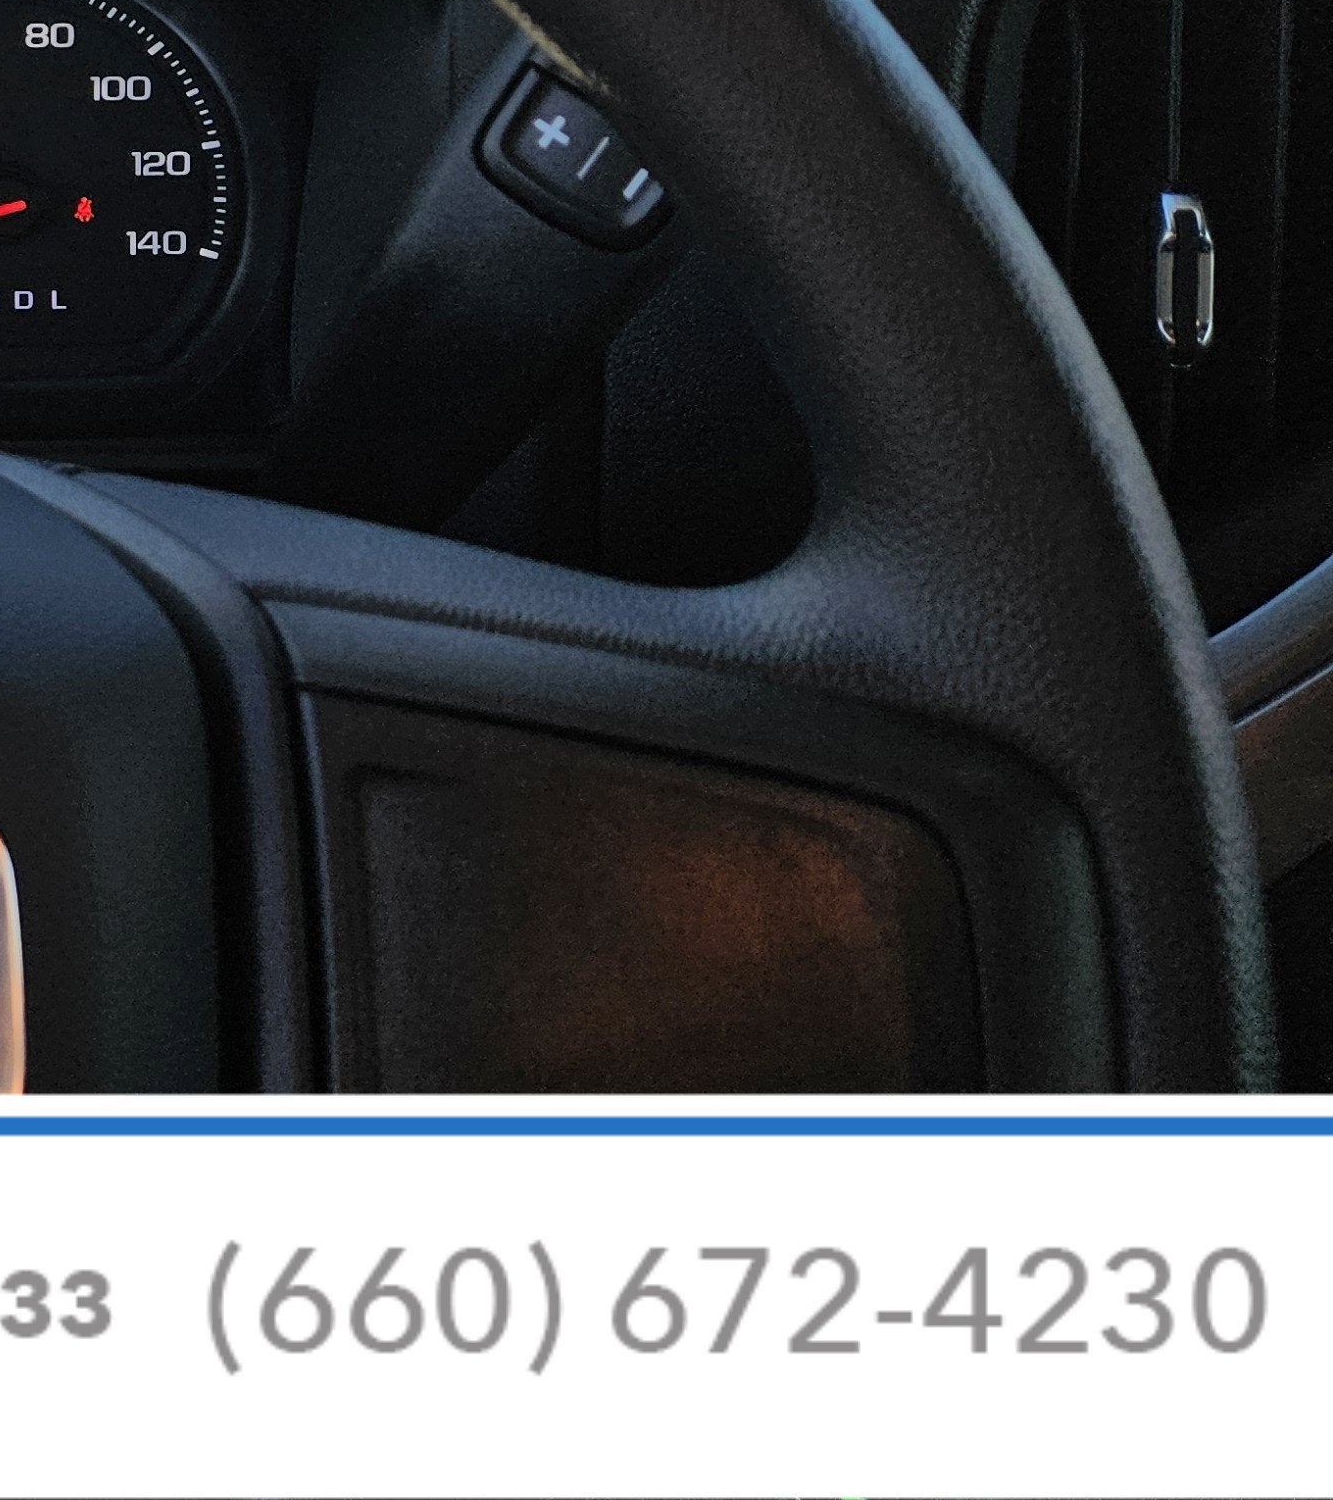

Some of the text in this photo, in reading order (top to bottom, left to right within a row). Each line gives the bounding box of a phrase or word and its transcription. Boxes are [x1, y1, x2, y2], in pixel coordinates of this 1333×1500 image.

[24, 22, 75, 49] 80
[89, 75, 152, 102] 100
[130, 150, 191, 177] 120
[126, 230, 187, 256] 140
[13, 290, 34, 310] D
[50, 289, 68, 310] L
